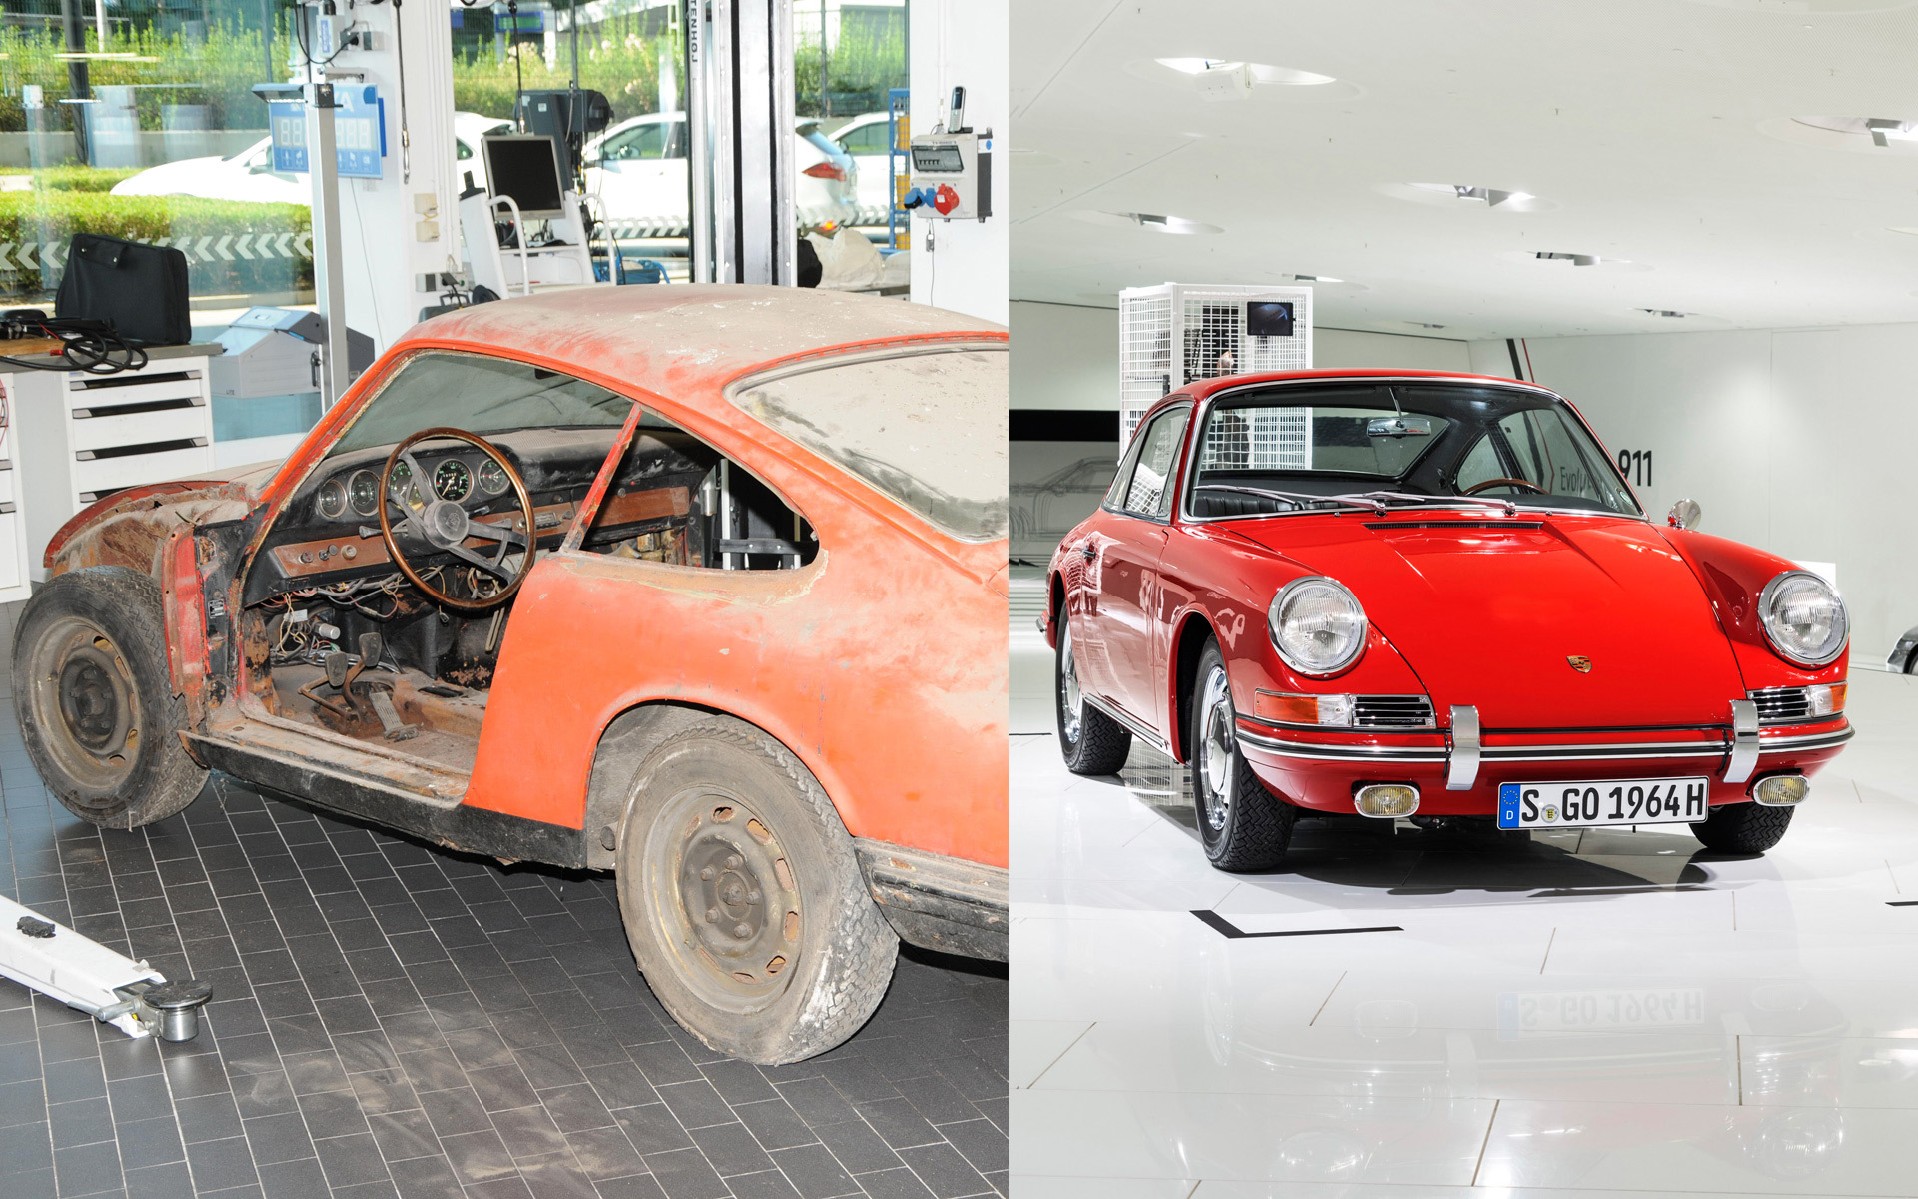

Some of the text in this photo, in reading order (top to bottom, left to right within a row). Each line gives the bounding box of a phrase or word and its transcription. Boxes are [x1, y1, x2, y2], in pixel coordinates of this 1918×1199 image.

[1618, 449, 1652, 487] 911
[1506, 810, 1514, 820] D
[1521, 789, 1540, 822] S
[1561, 787, 1600, 821] GO
